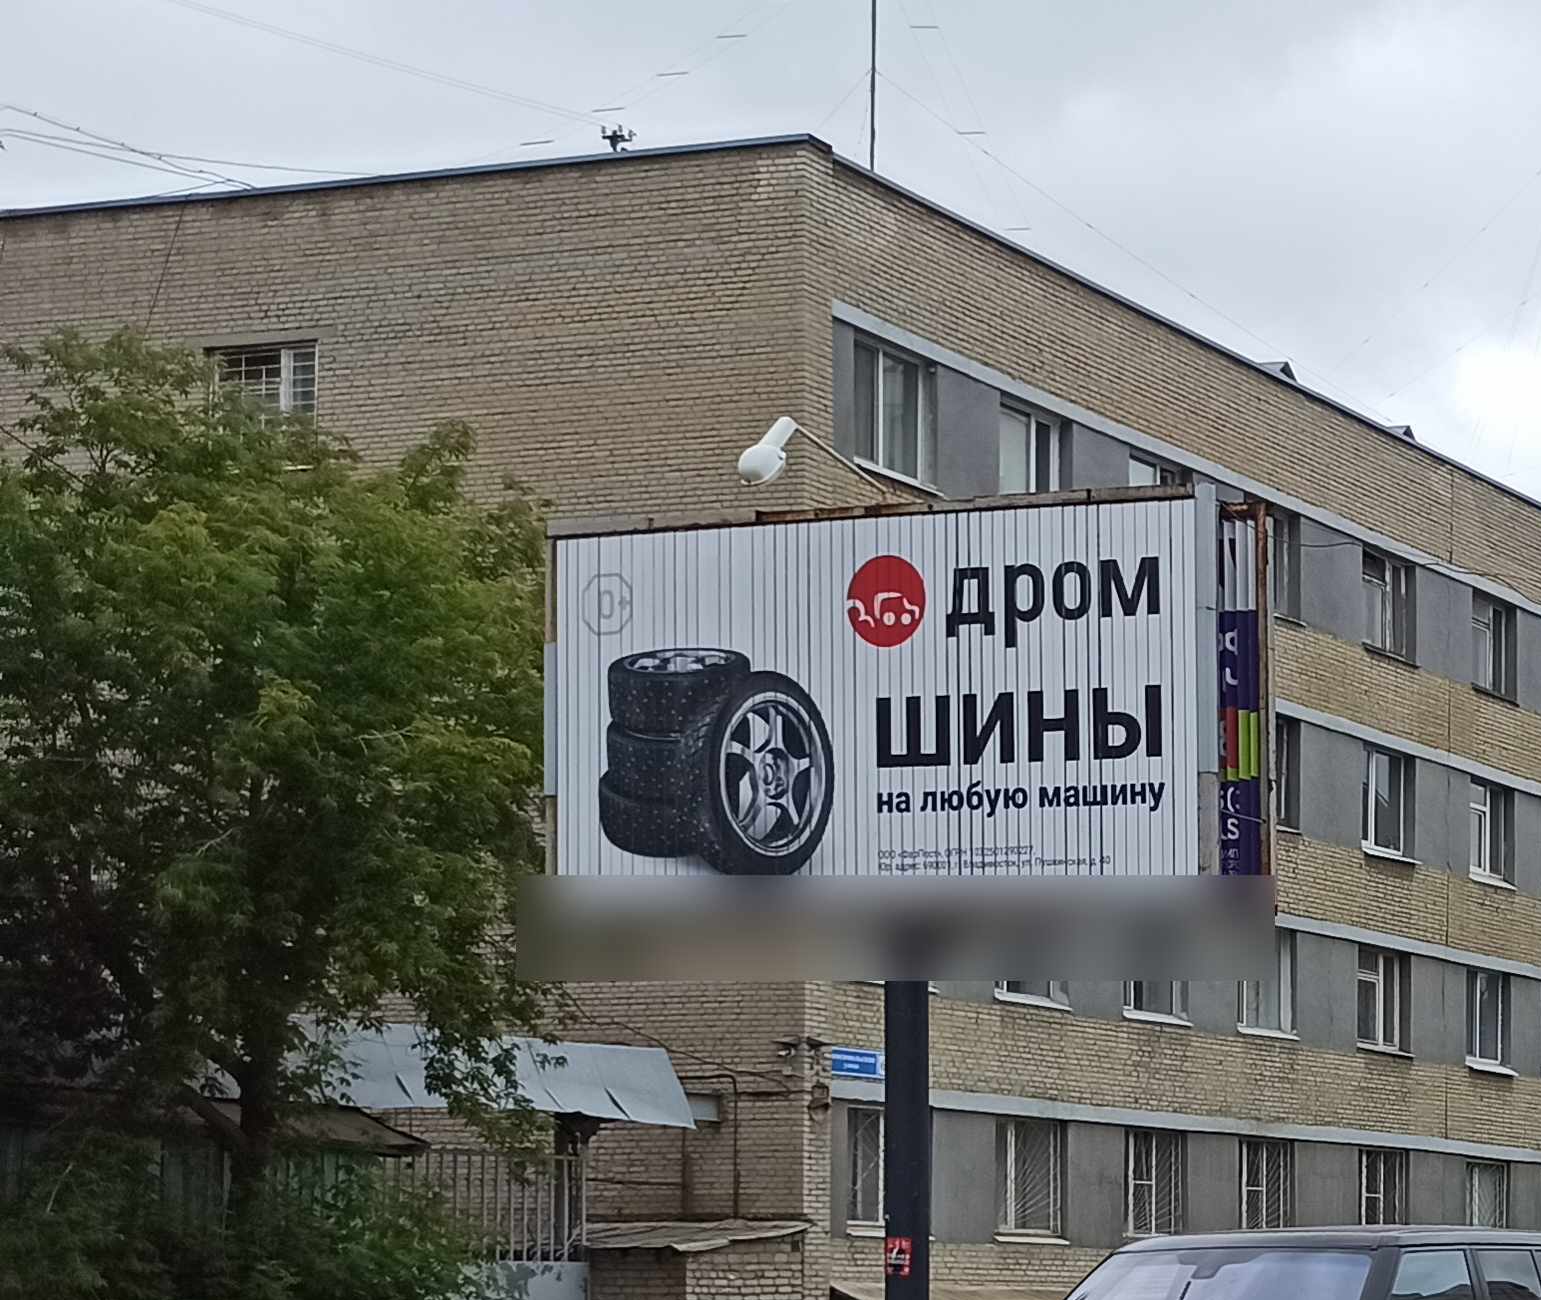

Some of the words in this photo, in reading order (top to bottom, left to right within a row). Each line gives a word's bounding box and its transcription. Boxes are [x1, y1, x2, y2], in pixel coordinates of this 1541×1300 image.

[946, 556, 1161, 649] дром
[876, 791, 911, 813] на
[920, 780, 1028, 818] любую
[1038, 781, 1166, 812] машину
